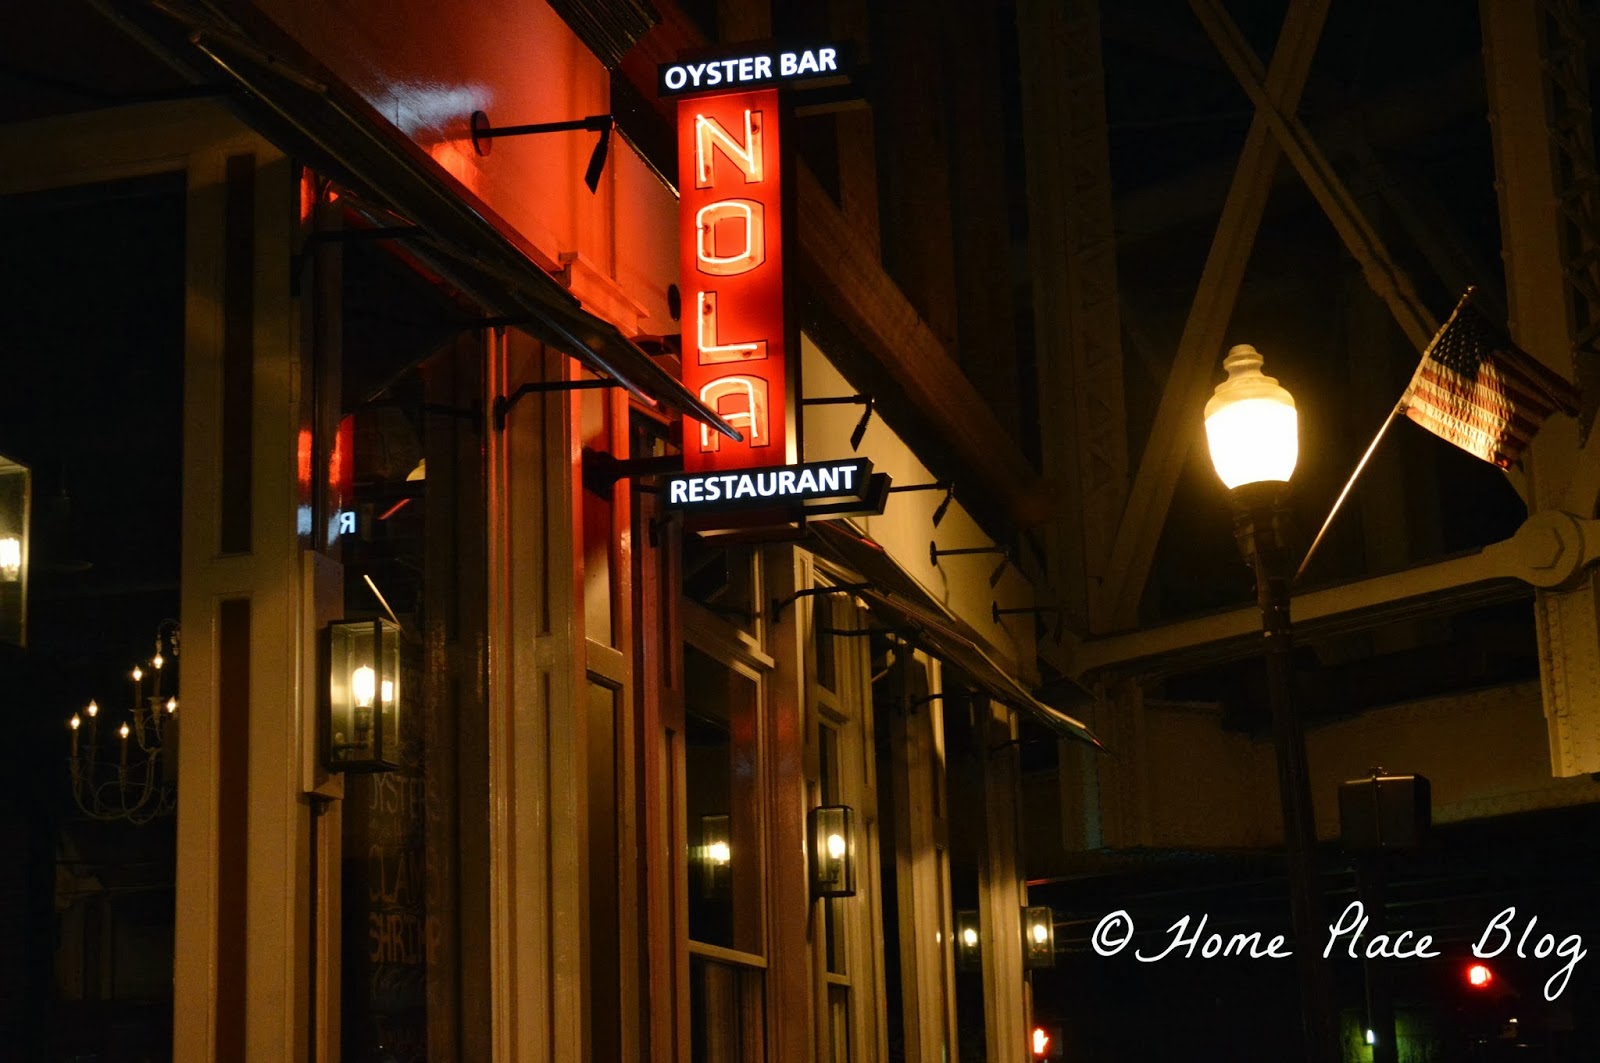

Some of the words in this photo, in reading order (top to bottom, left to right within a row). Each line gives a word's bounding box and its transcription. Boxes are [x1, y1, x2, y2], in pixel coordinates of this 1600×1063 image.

[665, 56, 772, 89] OYSTER
[781, 48, 837, 75] BAR
[694, 109, 770, 453] NOLA
[671, 465, 857, 503] RESTAURANT
